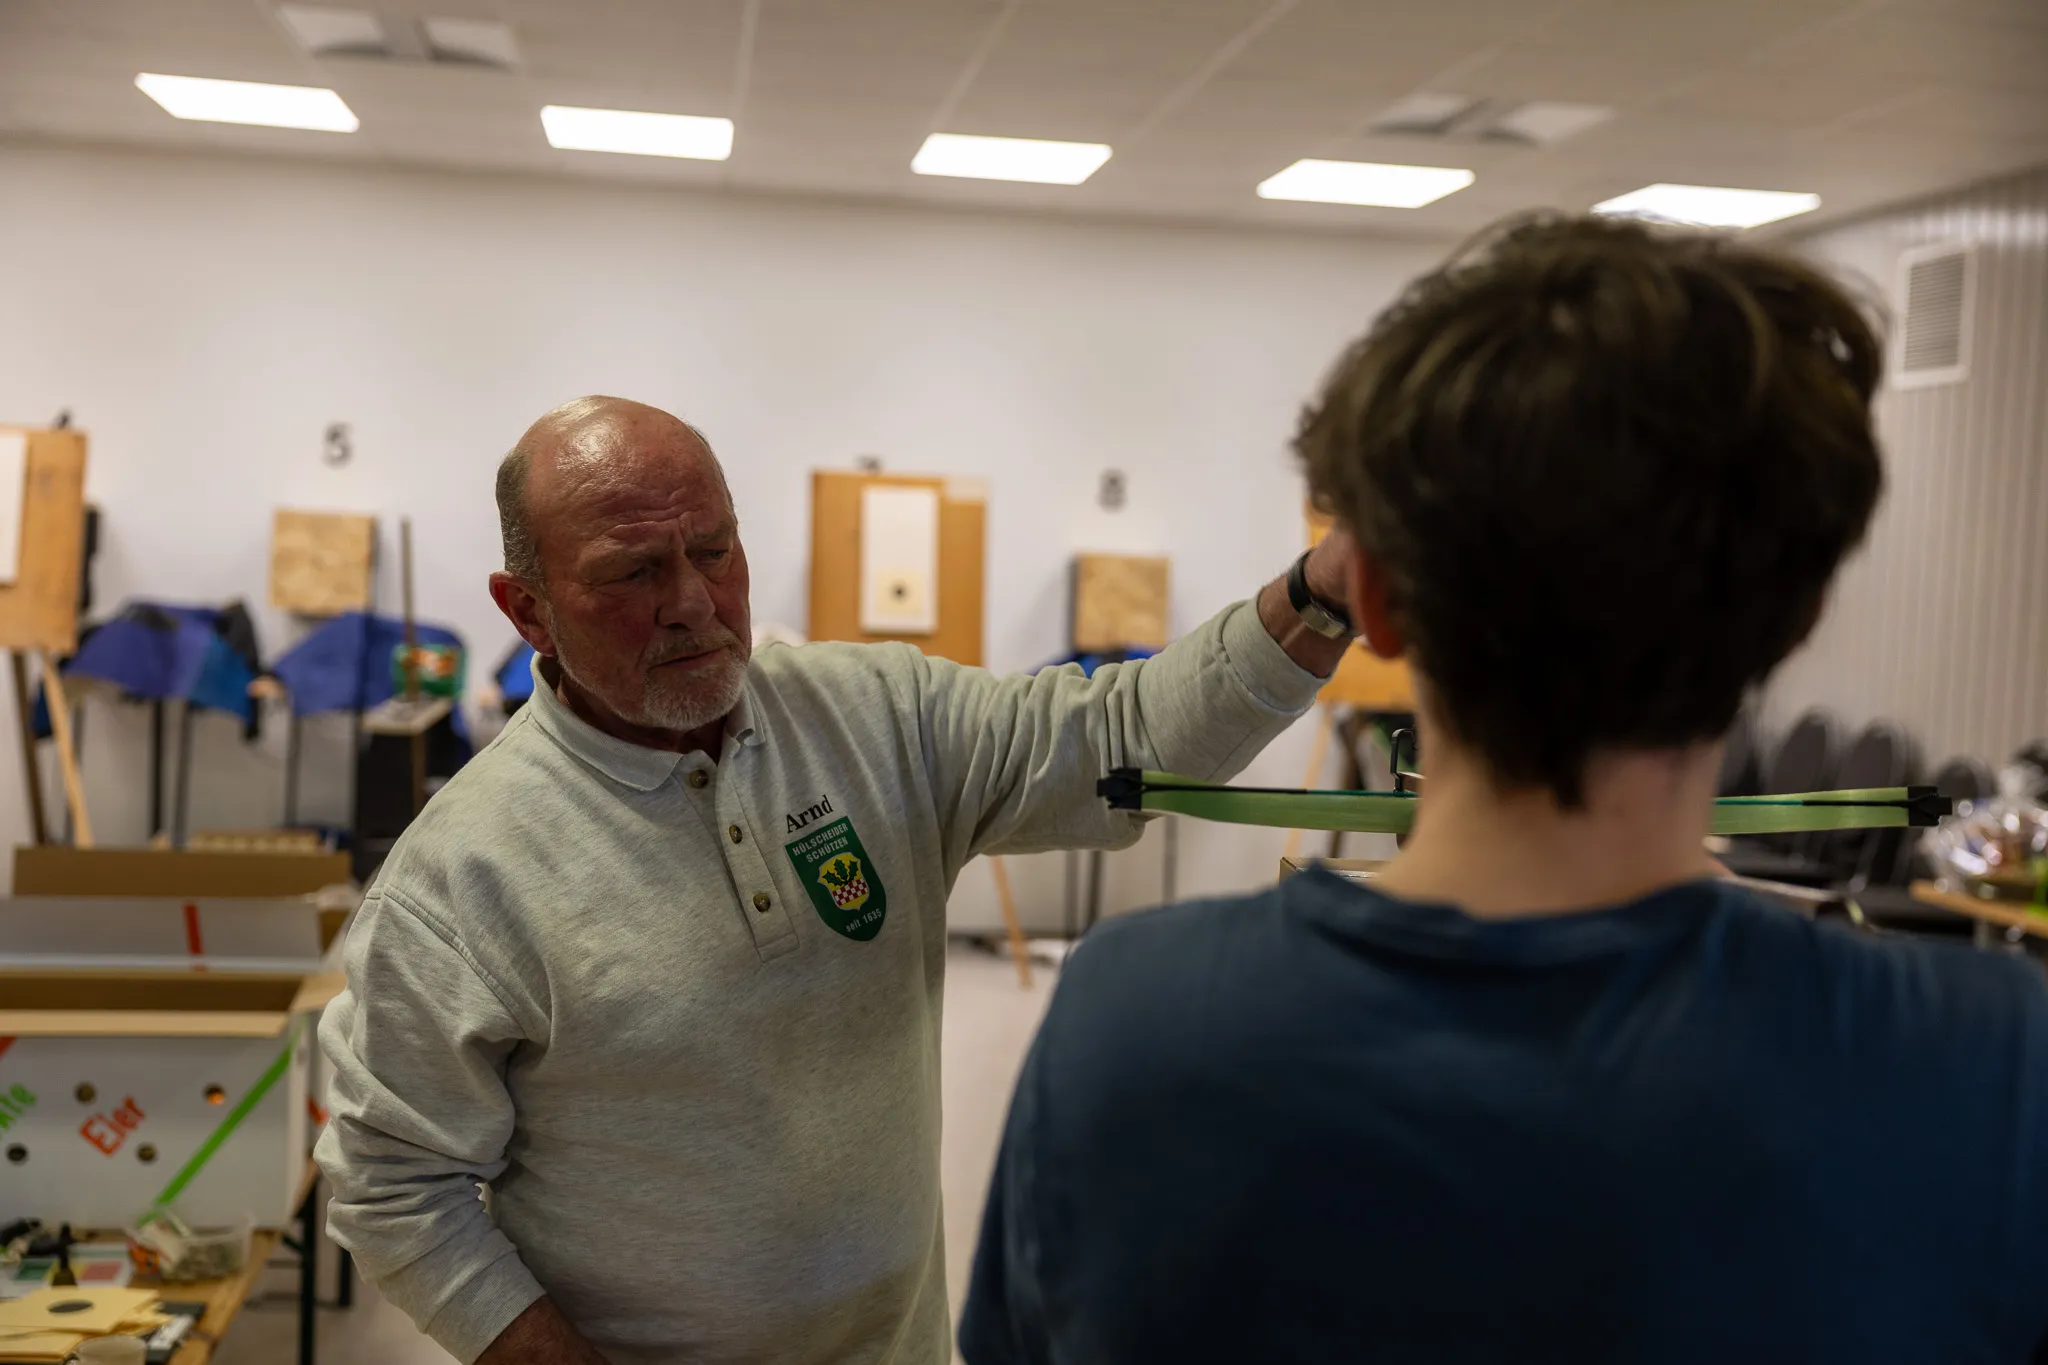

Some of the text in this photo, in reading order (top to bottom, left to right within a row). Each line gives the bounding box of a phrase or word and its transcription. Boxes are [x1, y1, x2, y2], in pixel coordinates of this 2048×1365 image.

[785, 794, 834, 834] Arnd
[792, 822, 849, 857] HÜLSCHEIDER
[806, 836, 849, 863] SCHÜTZEN
[845, 907, 883, 932] seit 1635
[79, 1095, 145, 1157] Eier
